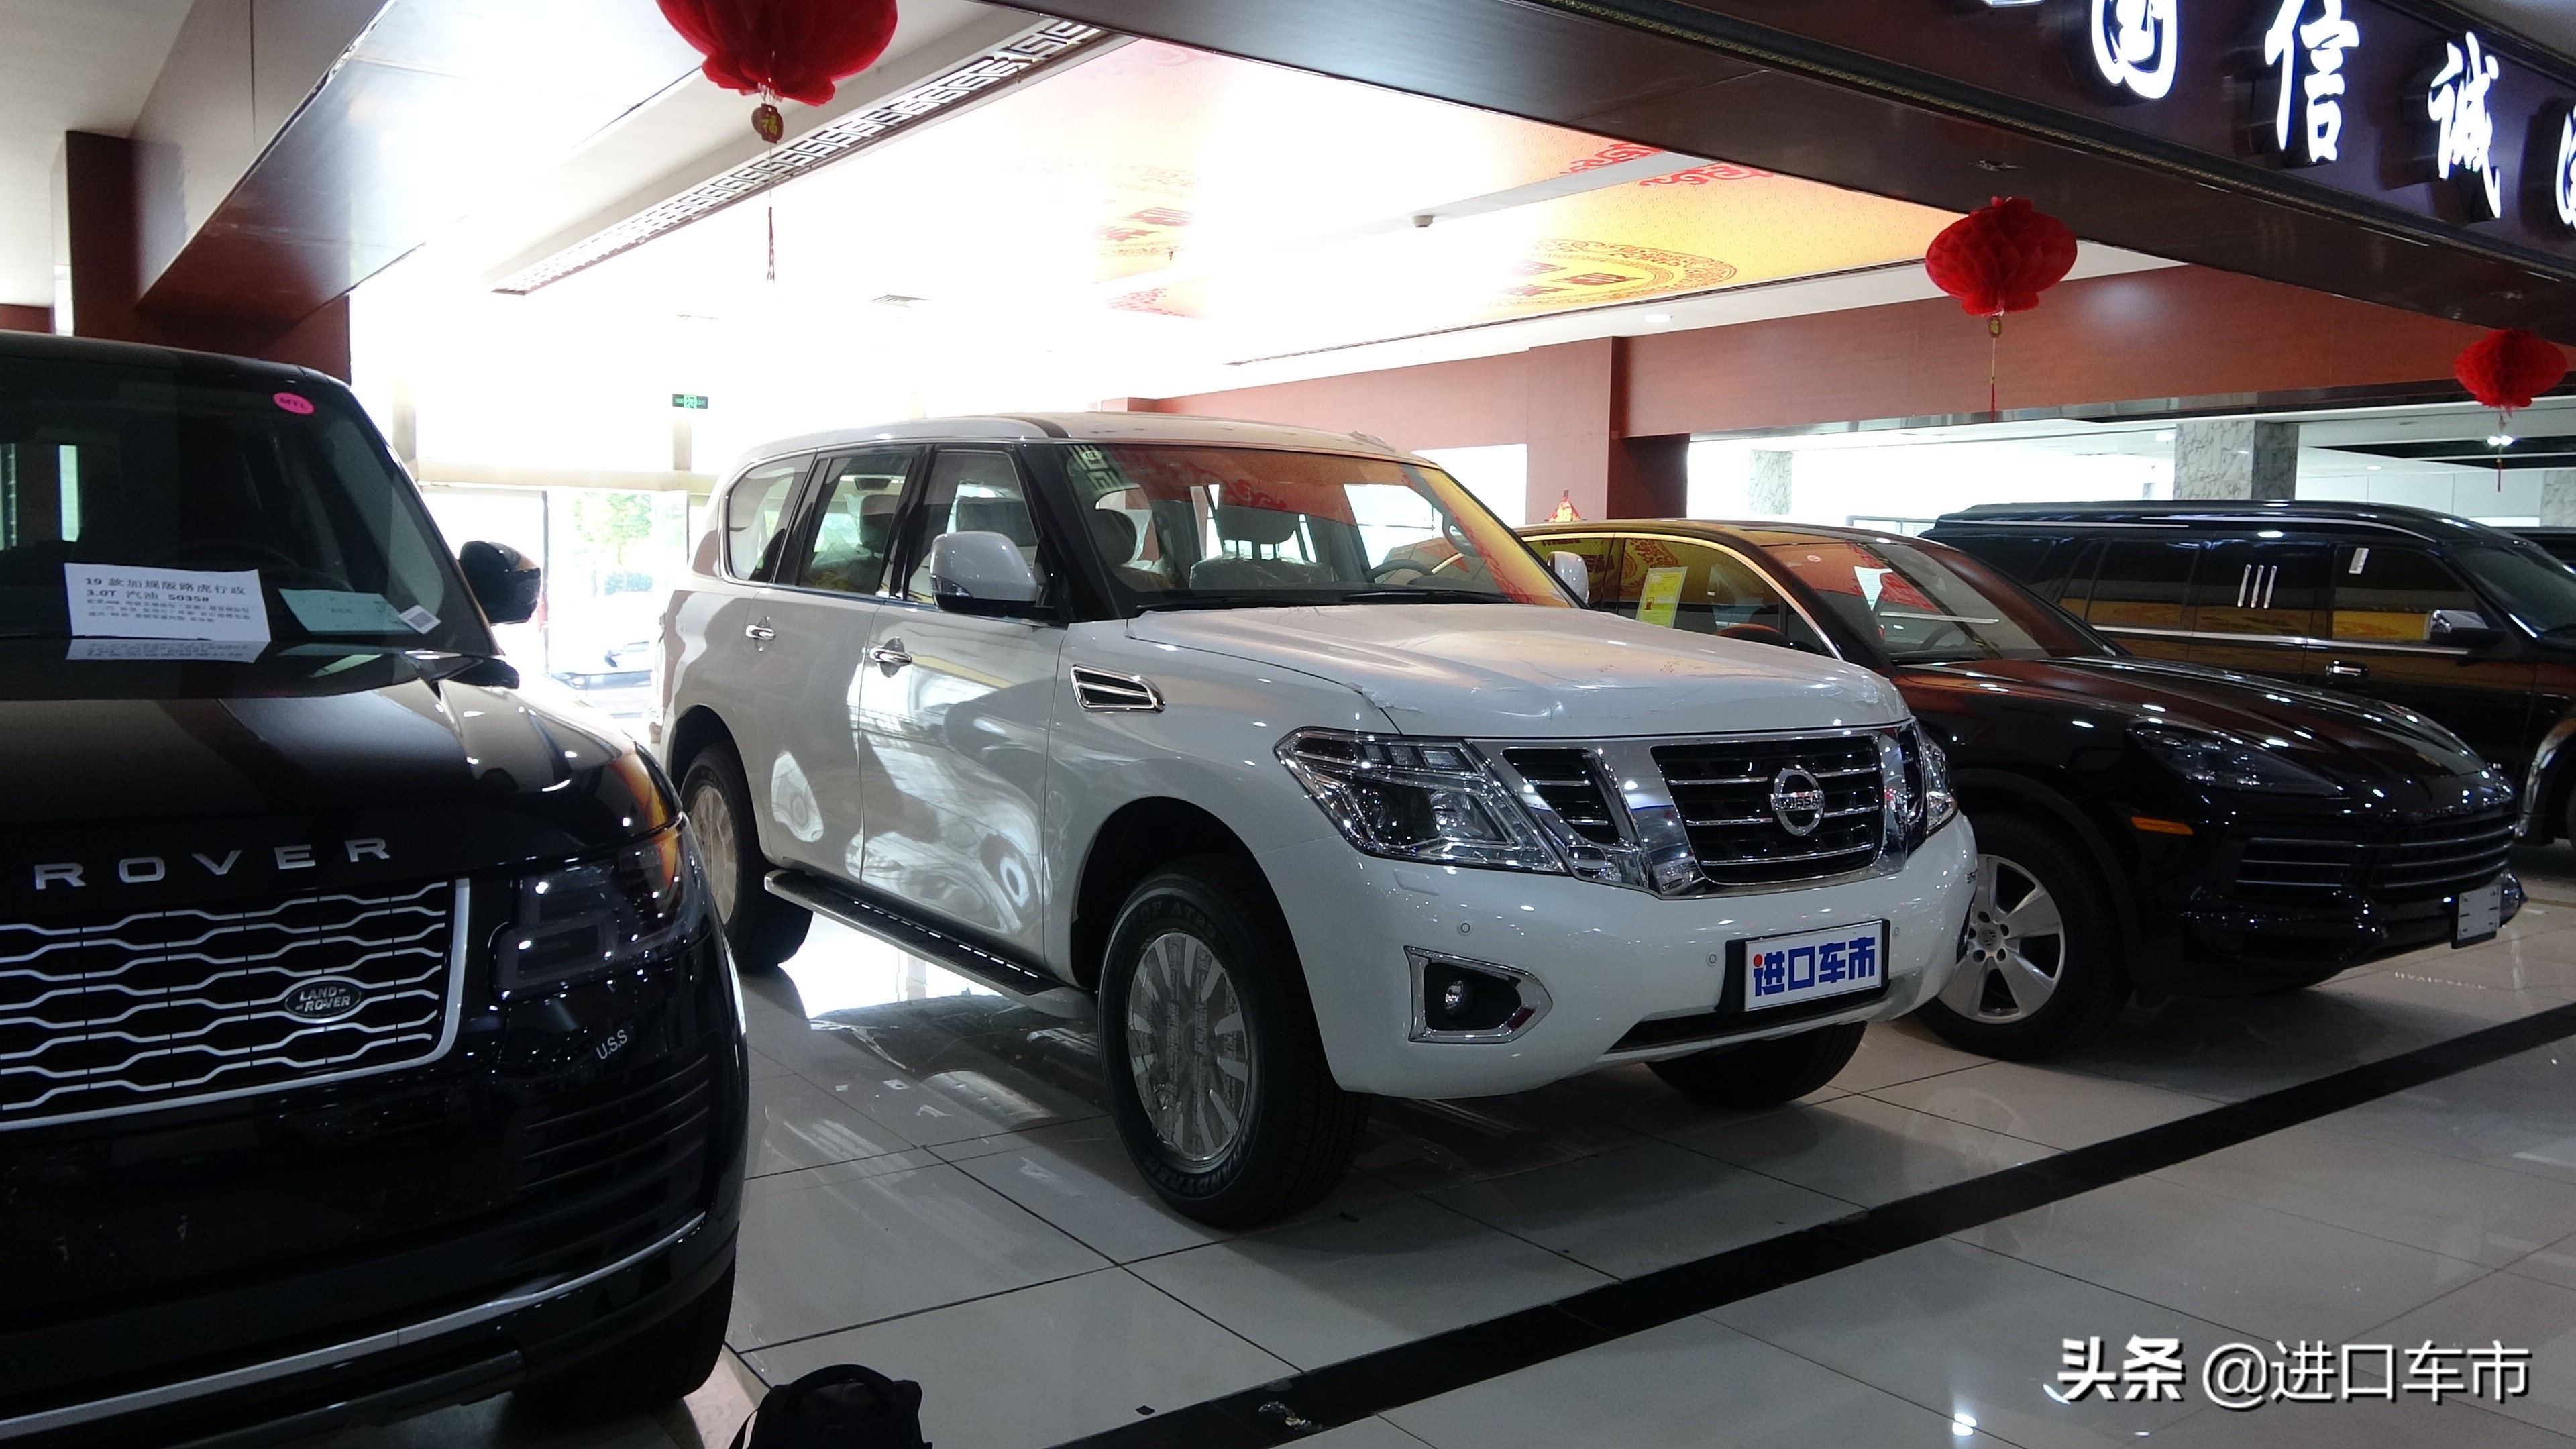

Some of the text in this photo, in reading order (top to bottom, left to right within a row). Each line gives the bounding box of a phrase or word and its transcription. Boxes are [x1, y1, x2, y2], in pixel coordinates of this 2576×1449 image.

[86, 589, 117, 598] 3.0T
[125, 590, 159, 601] 汽油
[34, 837, 391, 890] ROVER
[1753, 936, 1876, 997] 进口车市
